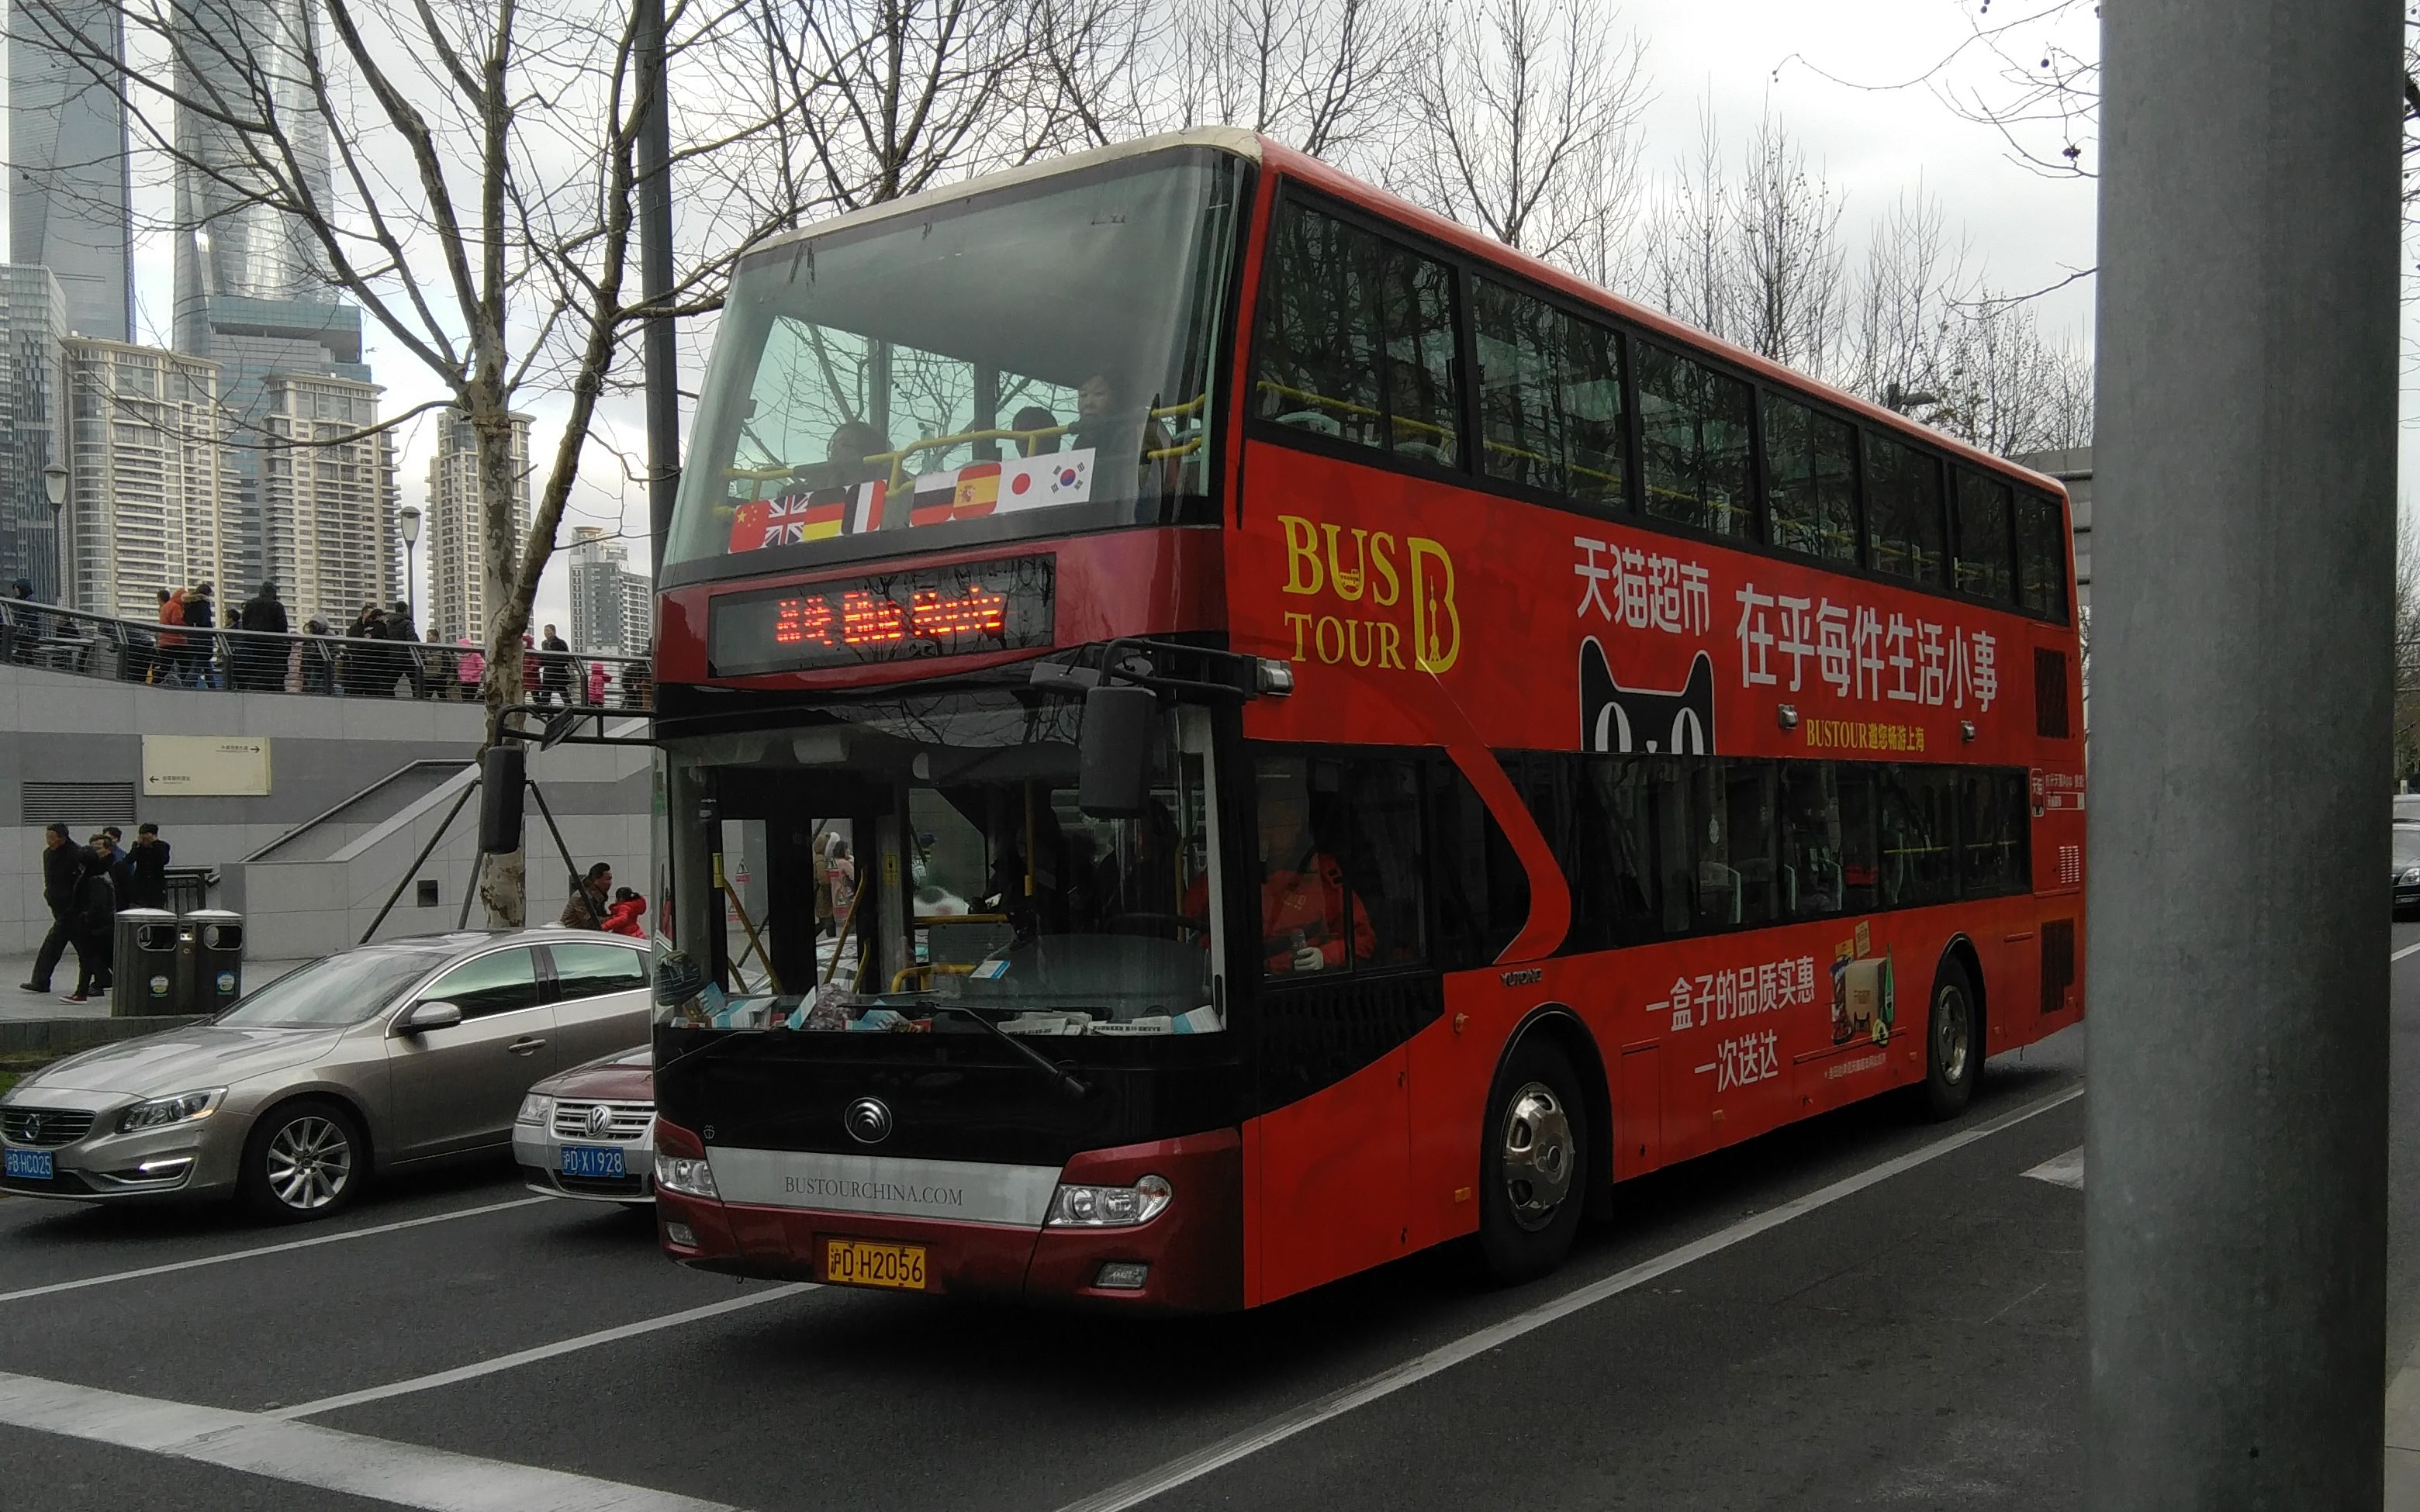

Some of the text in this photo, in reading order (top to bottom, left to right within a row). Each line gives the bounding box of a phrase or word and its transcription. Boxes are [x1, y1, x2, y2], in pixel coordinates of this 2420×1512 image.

[1277, 515, 1399, 606] BUS
[1574, 536, 1710, 637] 天猫超市
[1284, 610, 1406, 670] TOUR
[1736, 582, 1998, 713] 在乎每件生活小事
[1499, 968, 1542, 986] YUTONG
[1646, 955, 1815, 1032] 一盒子的品质实惠
[1695, 1029, 1779, 1093] 一次送达
[785, 1176, 963, 1206] BUSTOURCHINA.COM
